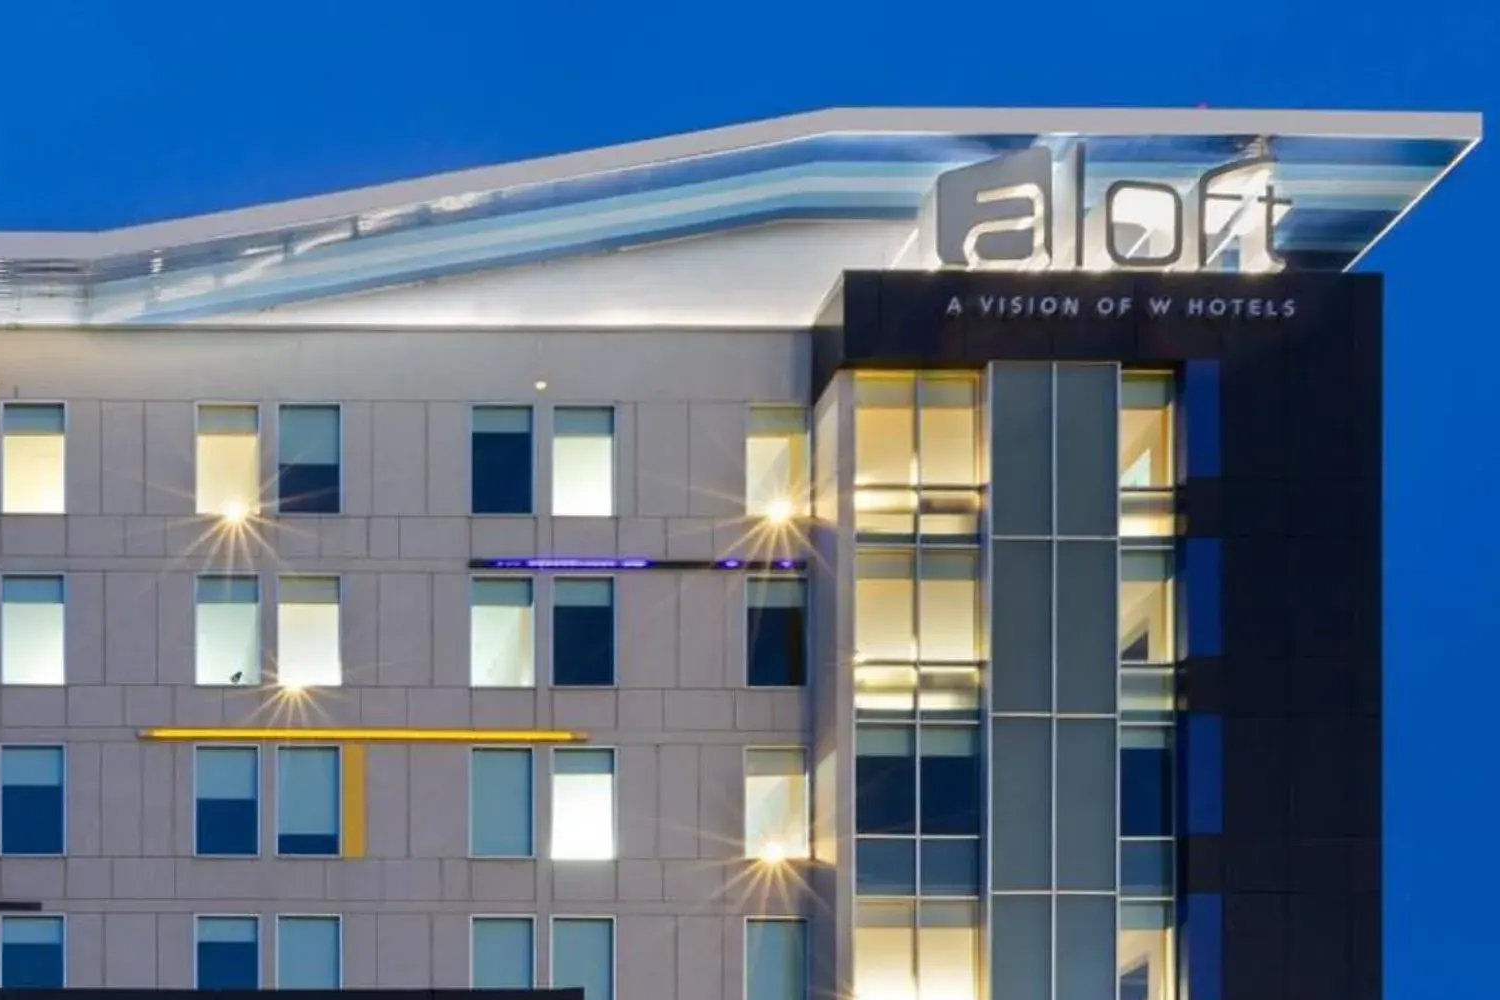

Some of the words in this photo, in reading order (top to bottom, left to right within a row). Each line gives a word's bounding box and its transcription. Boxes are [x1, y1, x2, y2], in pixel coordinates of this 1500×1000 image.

[936, 142, 1293, 274] aloft
[947, 298, 963, 315] A
[980, 297, 1079, 316] VISION
[1097, 297, 1133, 316] OF
[1149, 299, 1172, 316] W
[1188, 299, 1296, 317] HOTELS
